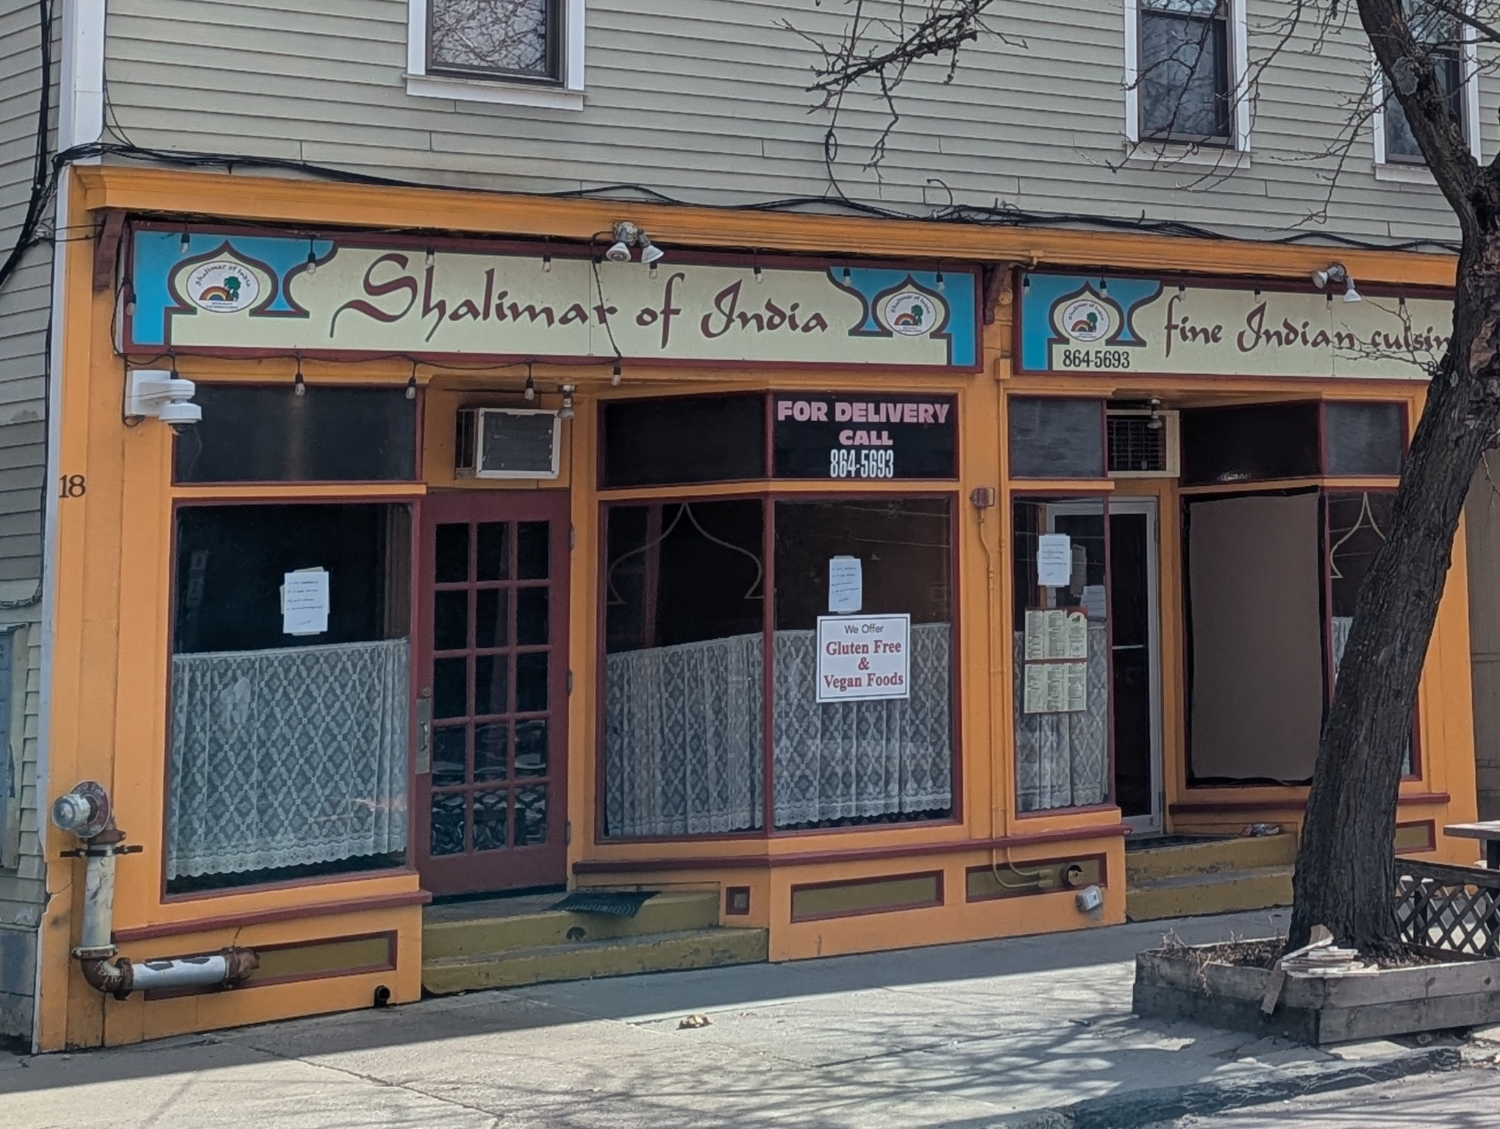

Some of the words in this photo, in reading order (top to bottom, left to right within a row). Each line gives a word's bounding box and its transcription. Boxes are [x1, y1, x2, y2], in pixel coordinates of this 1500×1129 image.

[330, 253, 618, 342] Shalimar
[635, 272, 685, 349] of
[700, 278, 829, 339] India
[1164, 295, 1223, 358] fine
[1237, 301, 1355, 353] Indian
[1370, 326, 1452, 351] cuisin
[1063, 349, 1130, 369] 864-5693
[777, 400, 828, 422] FOR
[835, 402, 950, 424] DELIVERY
[838, 429, 894, 446] CALL
[830, 448, 894, 478] 864-5693
[59, 474, 86, 499] 18
[844, 624, 859, 634] We
[861, 623, 885, 634] Offer
[825, 641, 870, 656] Gluten
[873, 639, 902, 654] Free
[858, 656, 870, 671] &
[823, 674, 863, 692] Vegan
[866, 672, 904, 687] Foods
